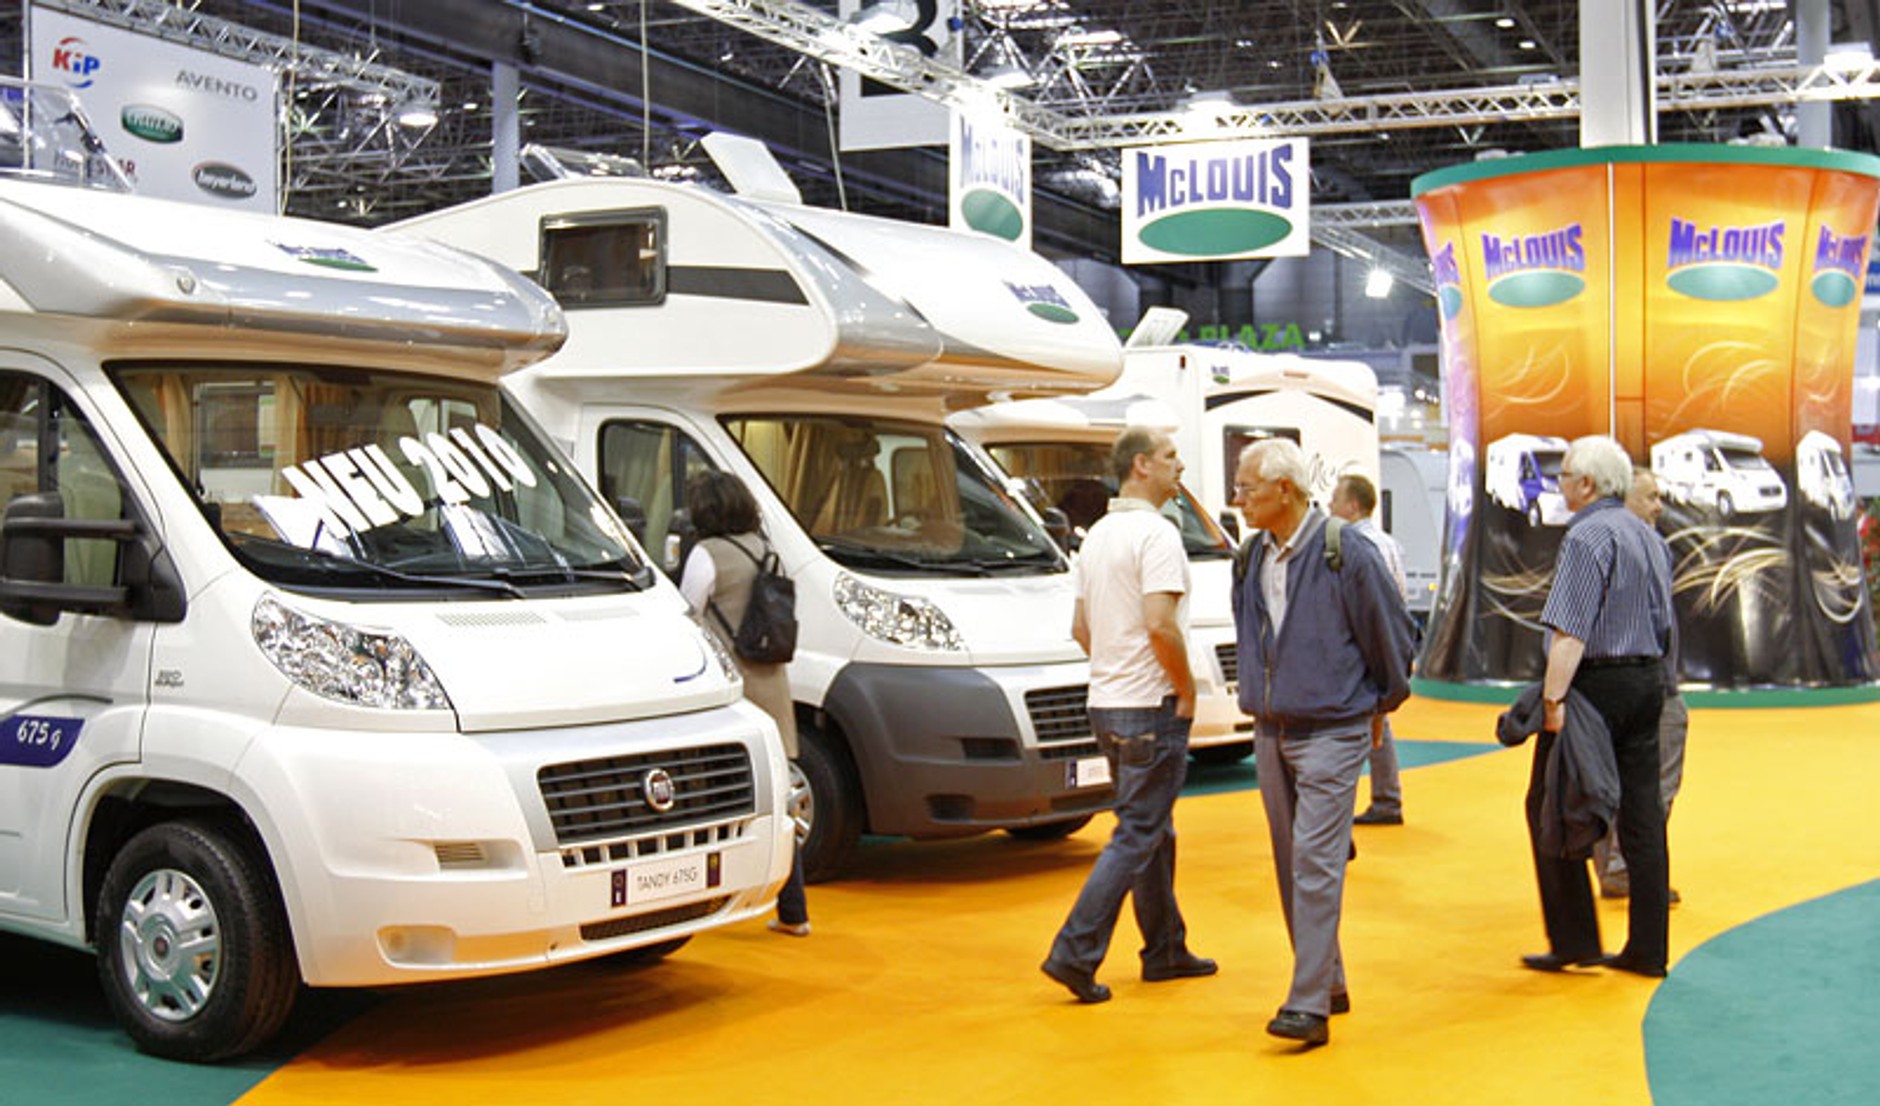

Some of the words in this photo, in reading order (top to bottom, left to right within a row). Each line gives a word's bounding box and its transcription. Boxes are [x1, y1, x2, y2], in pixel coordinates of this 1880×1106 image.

[176, 70, 258, 101] AVENTO
[1136, 143, 1294, 218] McLOUIS
[1481, 223, 1585, 281] McLOUIS
[1667, 217, 1784, 269] McLOUIS
[281, 444, 424, 538] NEU
[399, 423, 537, 502] 2010
[17, 720, 50, 745] 675
